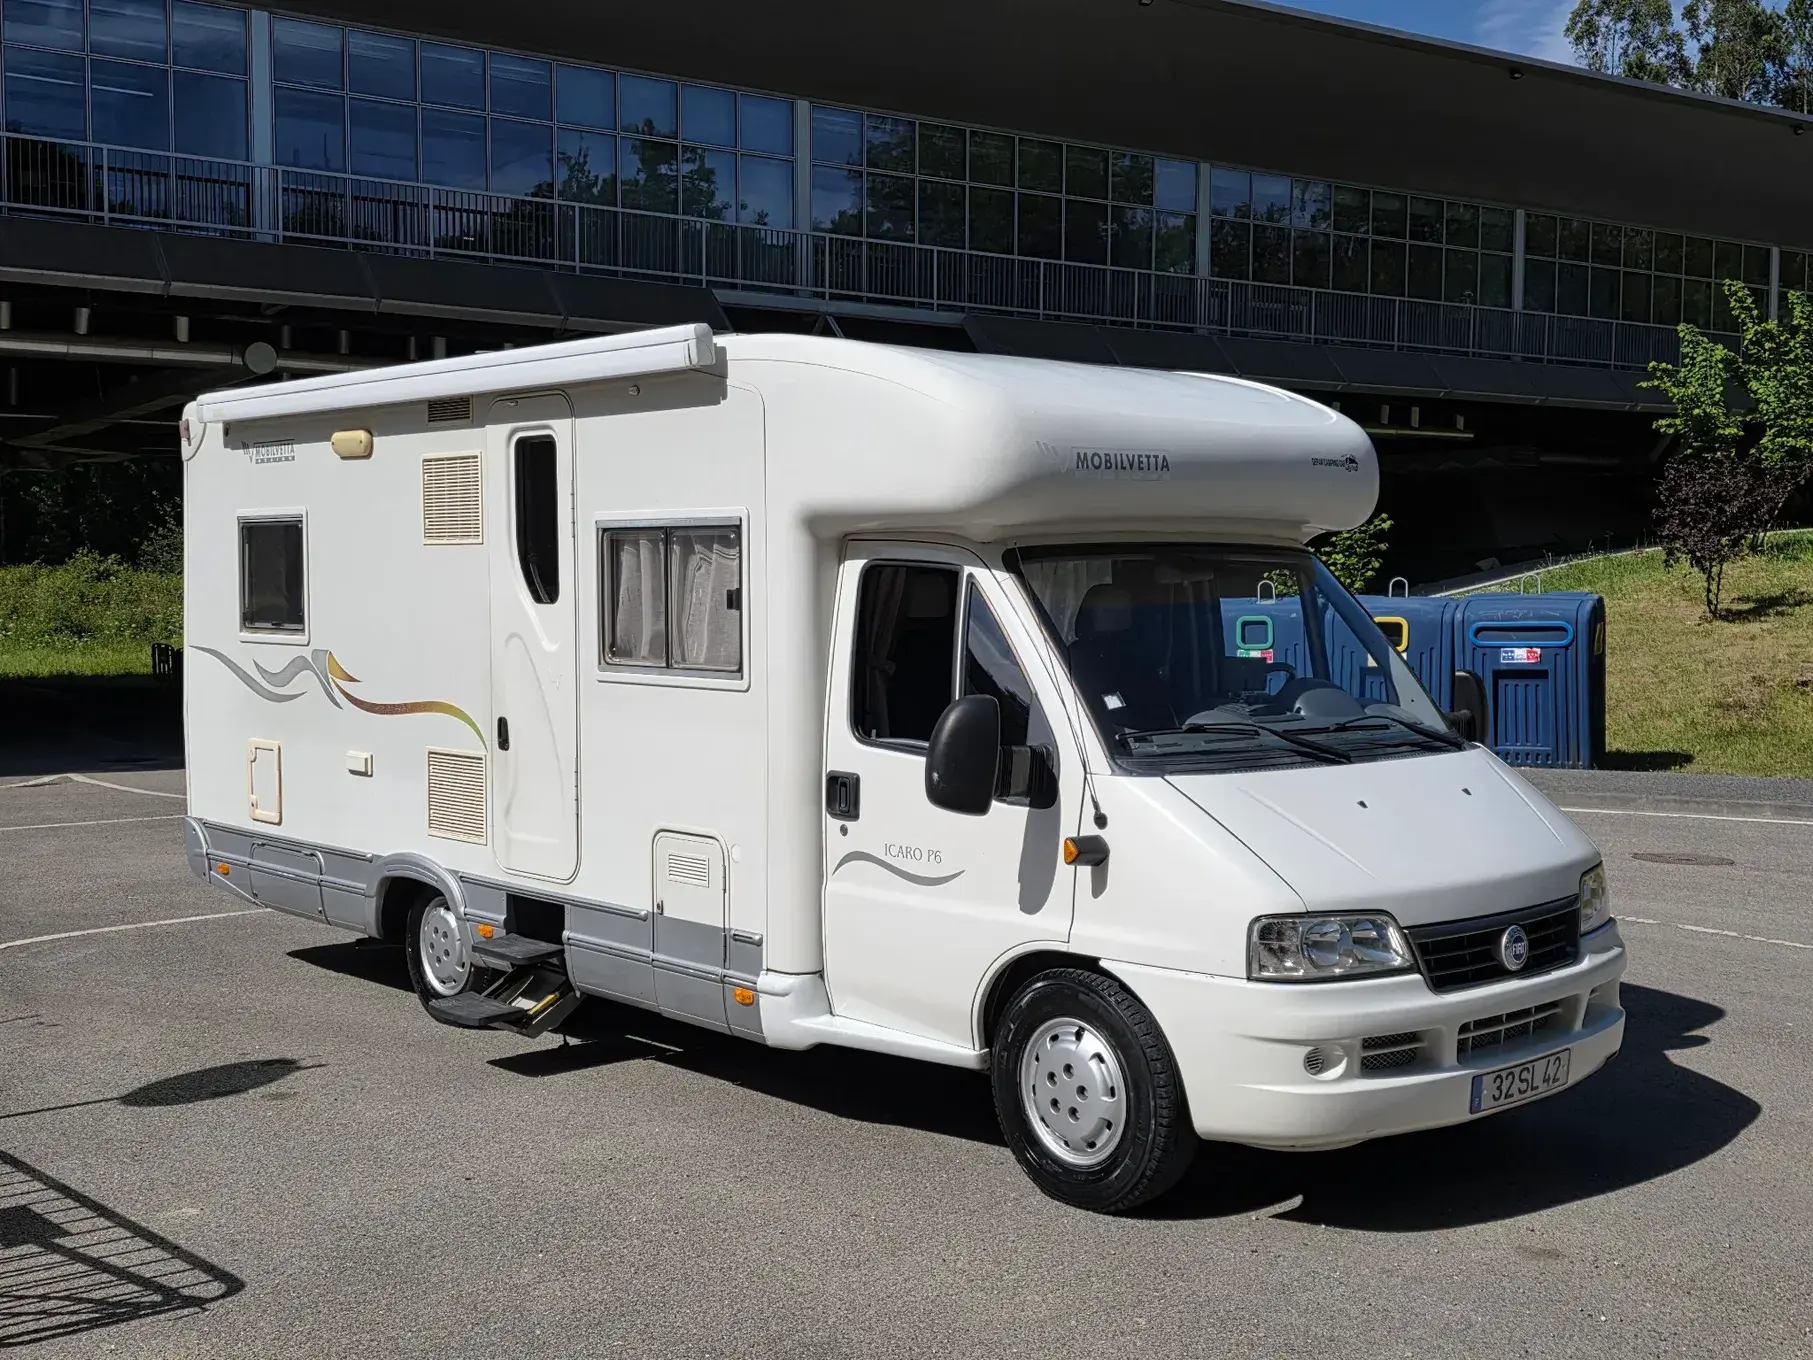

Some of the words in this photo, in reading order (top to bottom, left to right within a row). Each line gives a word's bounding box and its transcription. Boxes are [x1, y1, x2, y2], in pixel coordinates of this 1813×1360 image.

[255, 442, 295, 458] MOBILVETTA
[1076, 451, 1170, 471] MOBILVETTA
[884, 843, 923, 861] ICARO
[927, 849, 942, 864] P6
